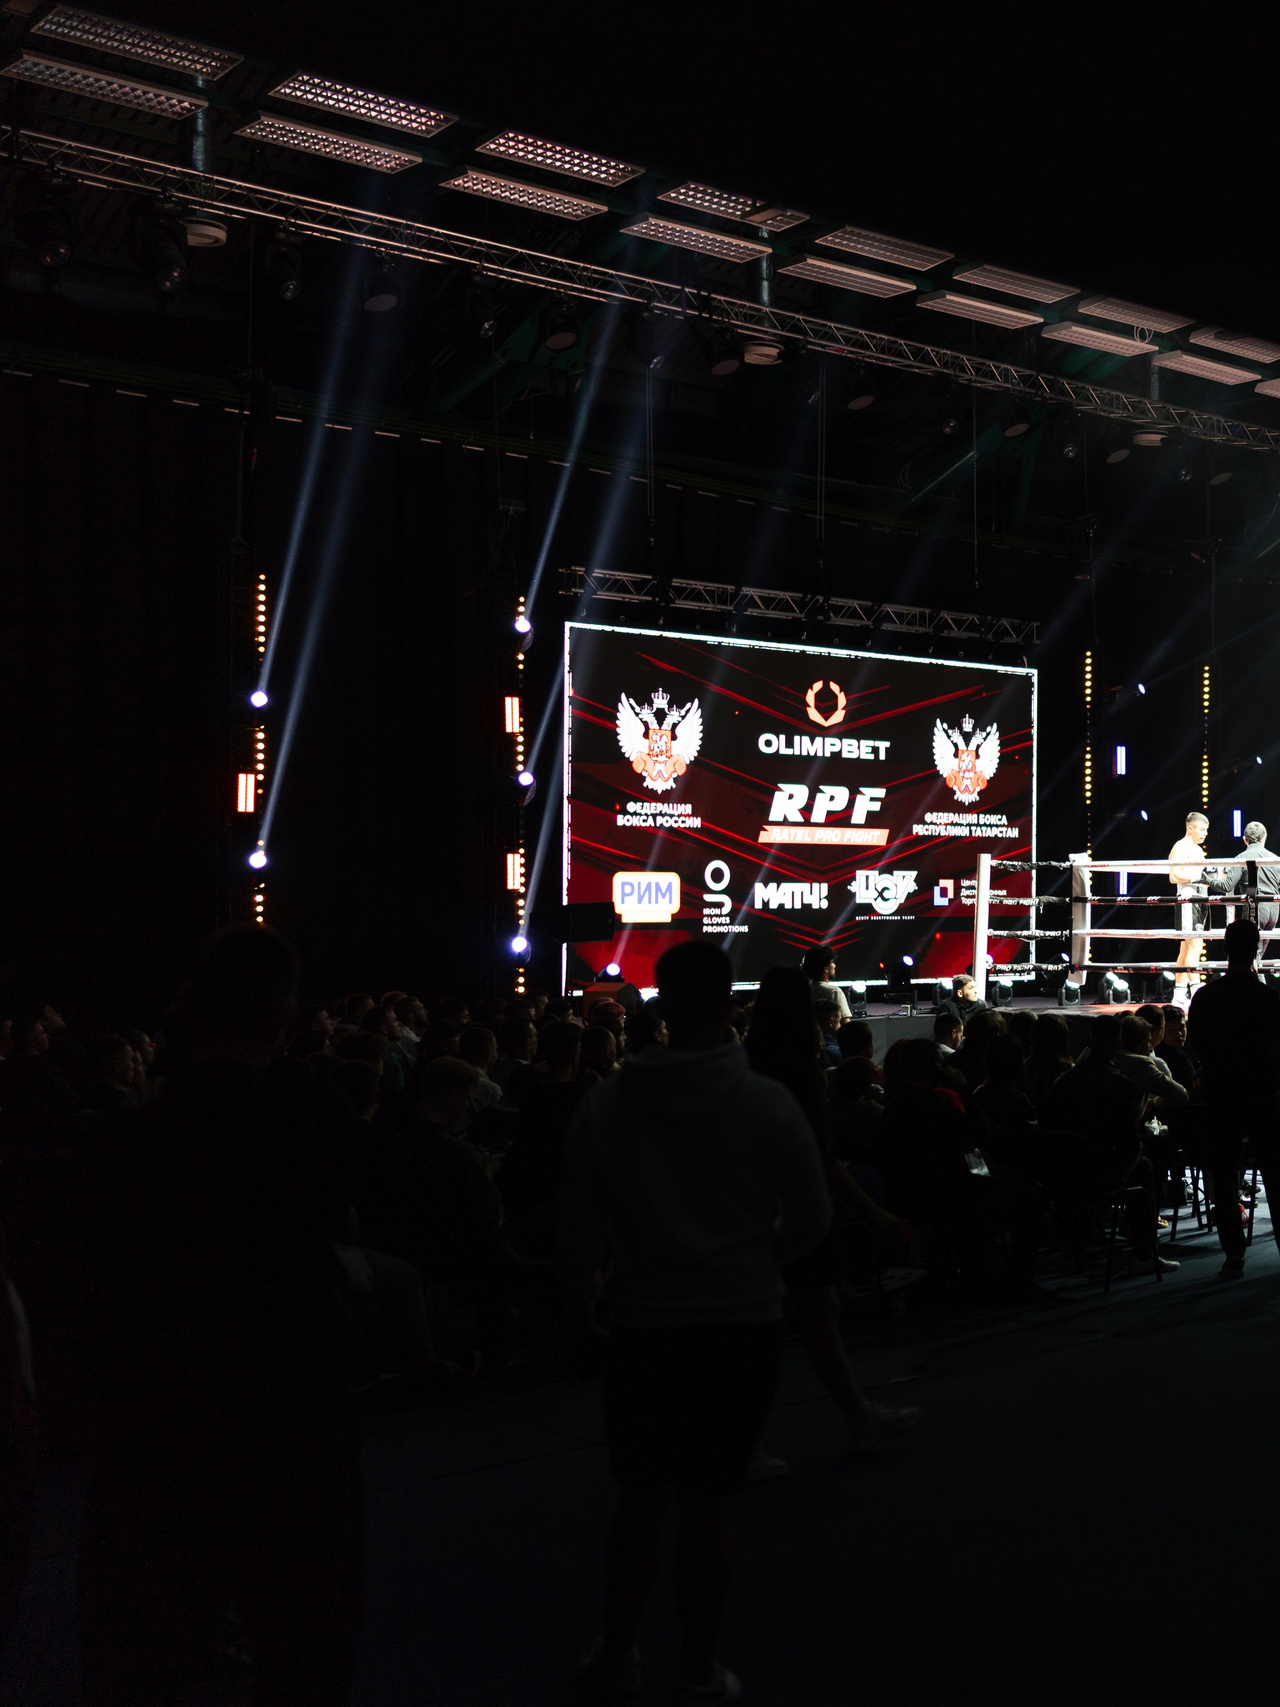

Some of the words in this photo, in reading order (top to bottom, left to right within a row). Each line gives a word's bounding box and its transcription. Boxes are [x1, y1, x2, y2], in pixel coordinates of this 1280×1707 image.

[758, 733, 890, 760] OLIMPBET
[626, 801, 692, 815] ФЕДЕРАЦИЯ
[769, 784, 887, 824] RPF
[616, 814, 655, 827] БОКСА
[656, 816, 701, 828] РОССИИ
[924, 812, 978, 825] ФЕДЕРАЦИЯ
[979, 814, 1008, 825] БОКСА
[770, 828, 811, 842] RATEL
[814, 830, 841, 843] PRO
[843, 831, 881, 843] FIGHT
[912, 824, 970, 837] РЕСПУБЛИКИ
[971, 827, 1019, 838] ТАТАРСТАН
[620, 881, 673, 905] РИМ
[754, 882, 829, 909] МАТЧ!
[703, 908, 720, 916] IRON
[703, 917, 731, 925] GLOVES
